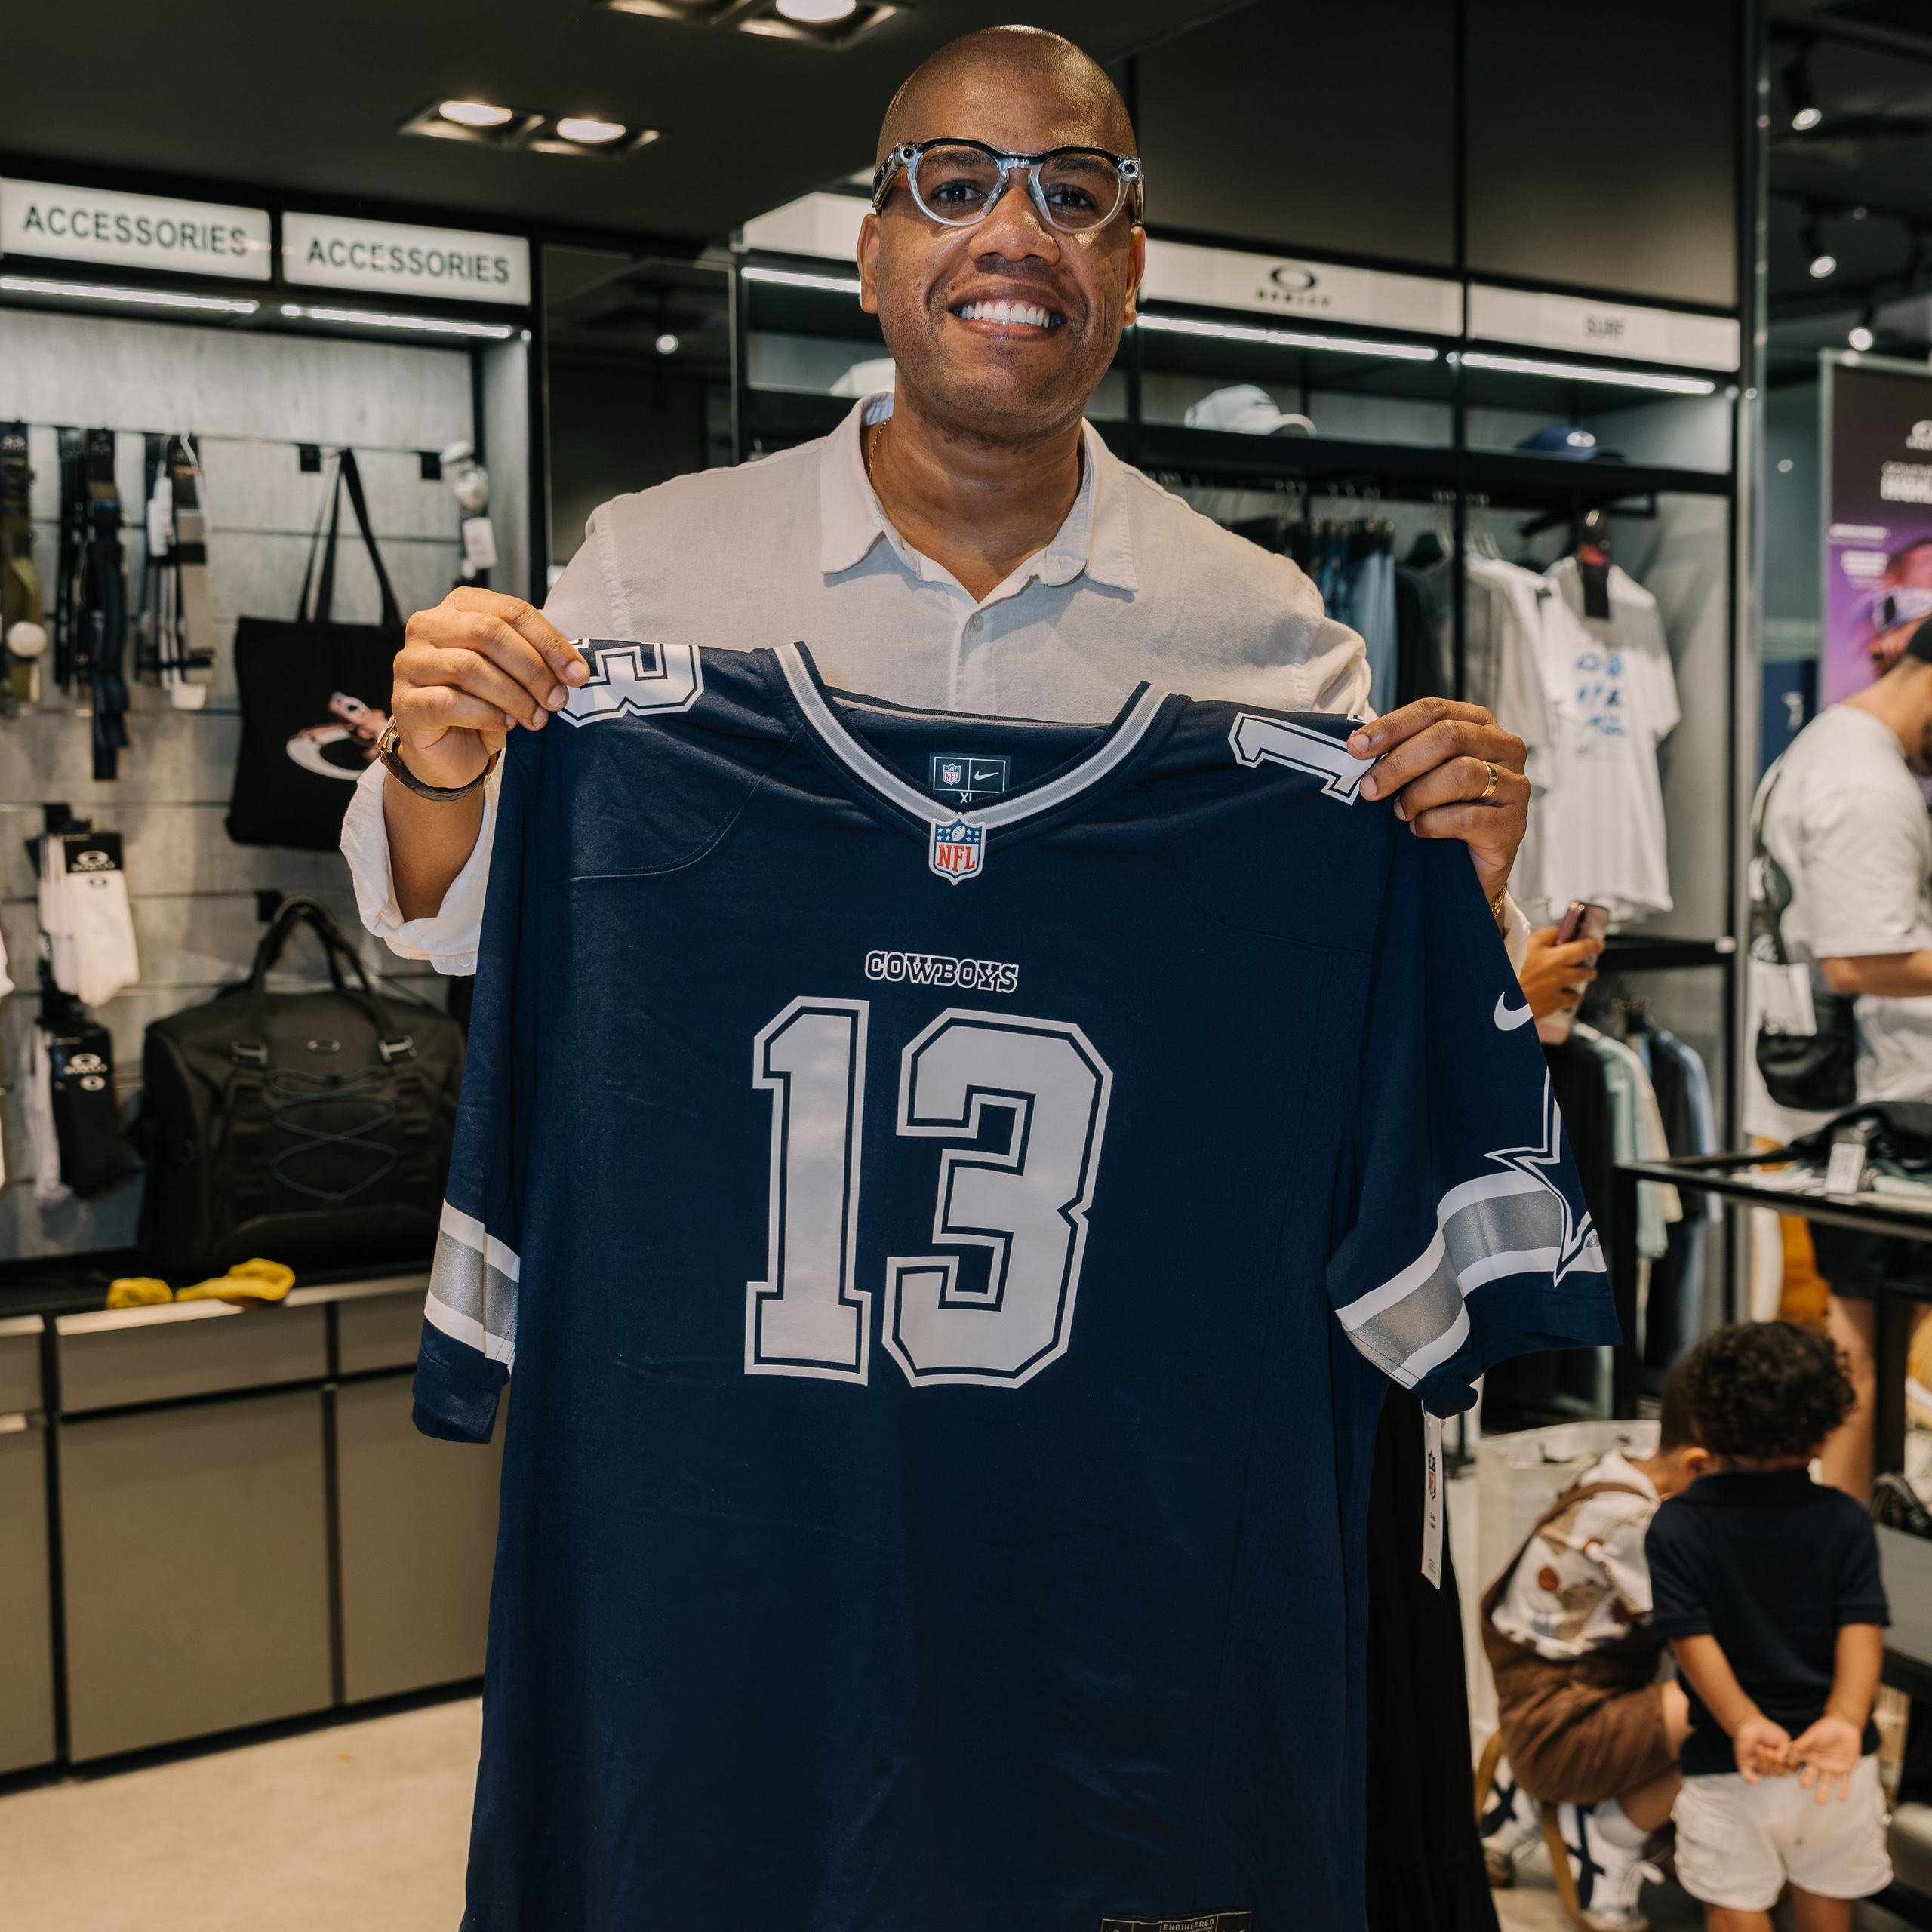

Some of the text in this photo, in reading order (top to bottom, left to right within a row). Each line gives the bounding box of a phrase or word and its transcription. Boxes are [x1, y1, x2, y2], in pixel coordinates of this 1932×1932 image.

[24, 205, 248, 257] ACCESSORIES
[307, 238, 510, 284] ACCESSORIES
[945, 773, 958, 782] NFL
[1228, 712, 1375, 805] 1
[937, 844, 976, 872] NFL
[865, 950, 1019, 993] COWBOYS
[744, 996, 1113, 1389] 13
[1163, 1918, 1214, 1931] ENGINEERED
